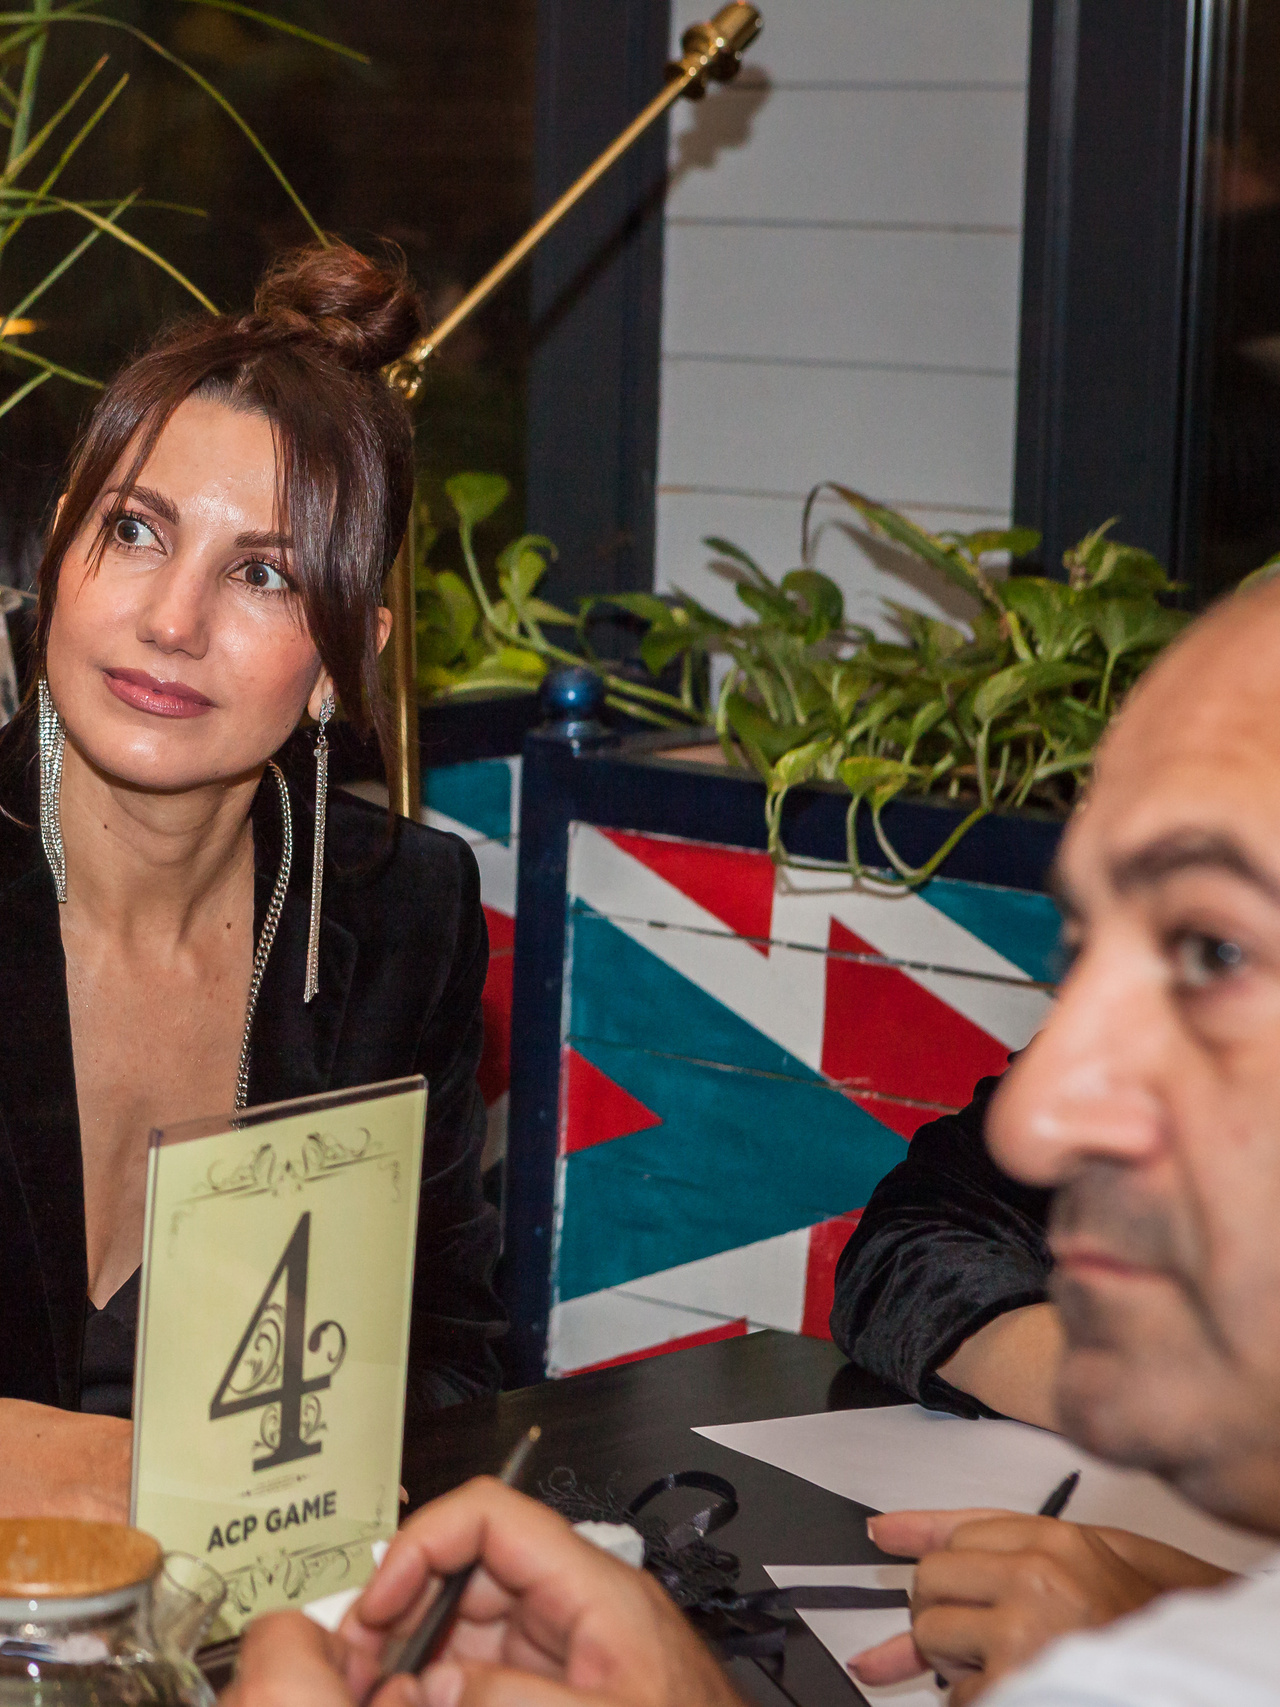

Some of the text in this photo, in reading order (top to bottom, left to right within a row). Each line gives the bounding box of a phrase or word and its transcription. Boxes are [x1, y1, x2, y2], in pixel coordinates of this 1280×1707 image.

[209, 1211, 346, 1472] 4
[207, 1490, 337, 1553] ACP GAME
